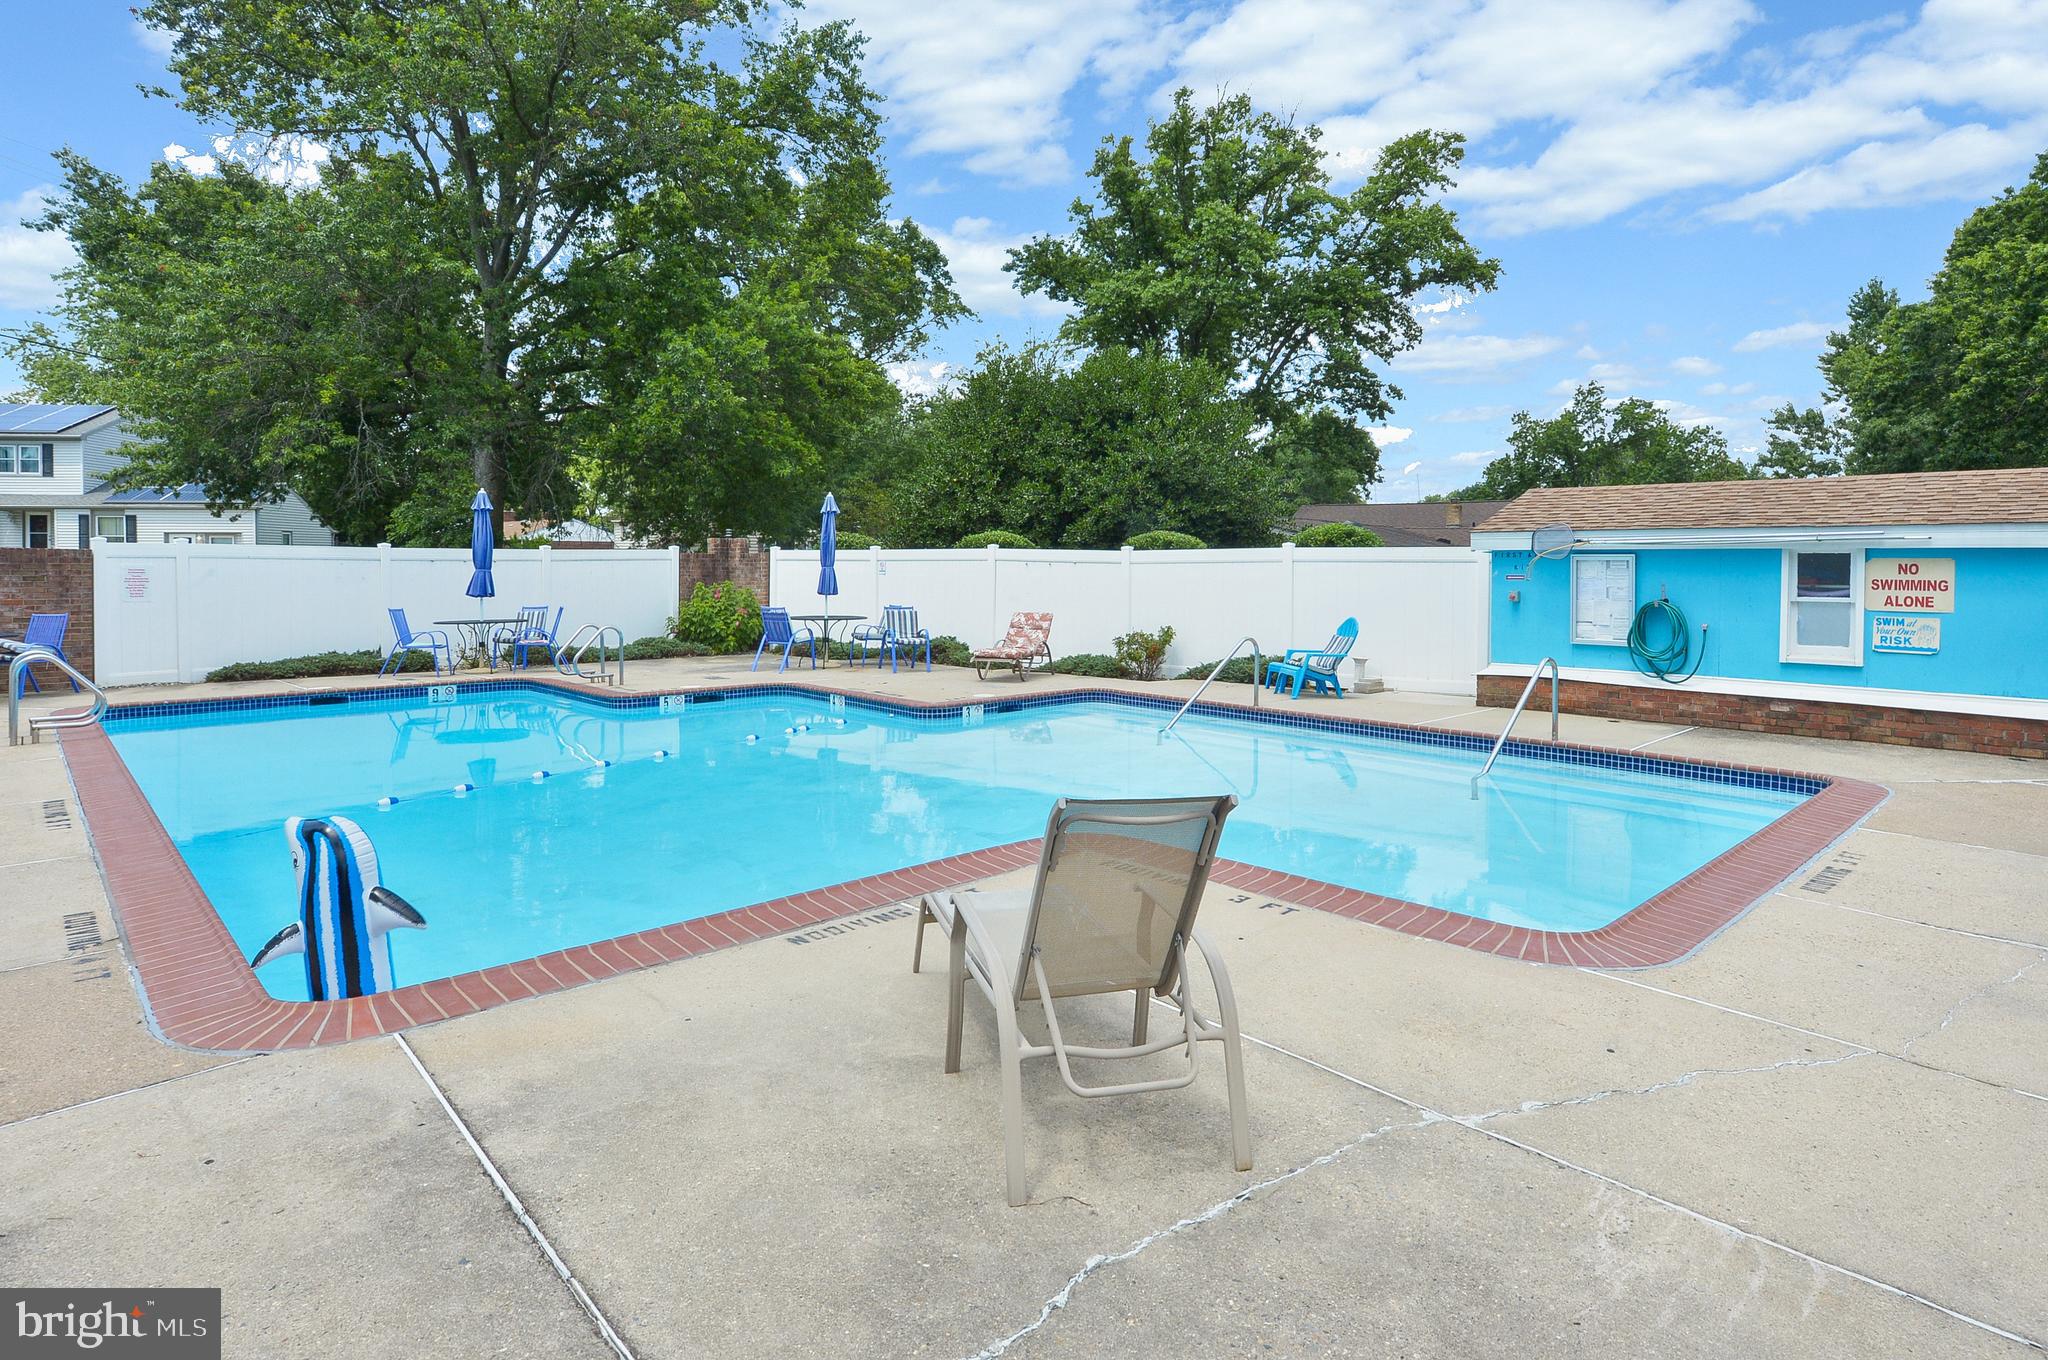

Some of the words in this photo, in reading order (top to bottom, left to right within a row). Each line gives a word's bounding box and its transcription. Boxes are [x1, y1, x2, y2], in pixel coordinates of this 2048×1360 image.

[1897, 563, 1920, 575] NO
[1871, 579, 1949, 592] SWIMMING
[1884, 595, 1935, 608] ALONE
[1875, 617, 1905, 627] SWIM
[1876, 626, 1896, 635] Your
[1896, 627, 1917, 636] Own
[1880, 636, 1912, 645] RISK
[1229, 894, 1250, 904] 3
[1259, 902, 1300, 916] FT
